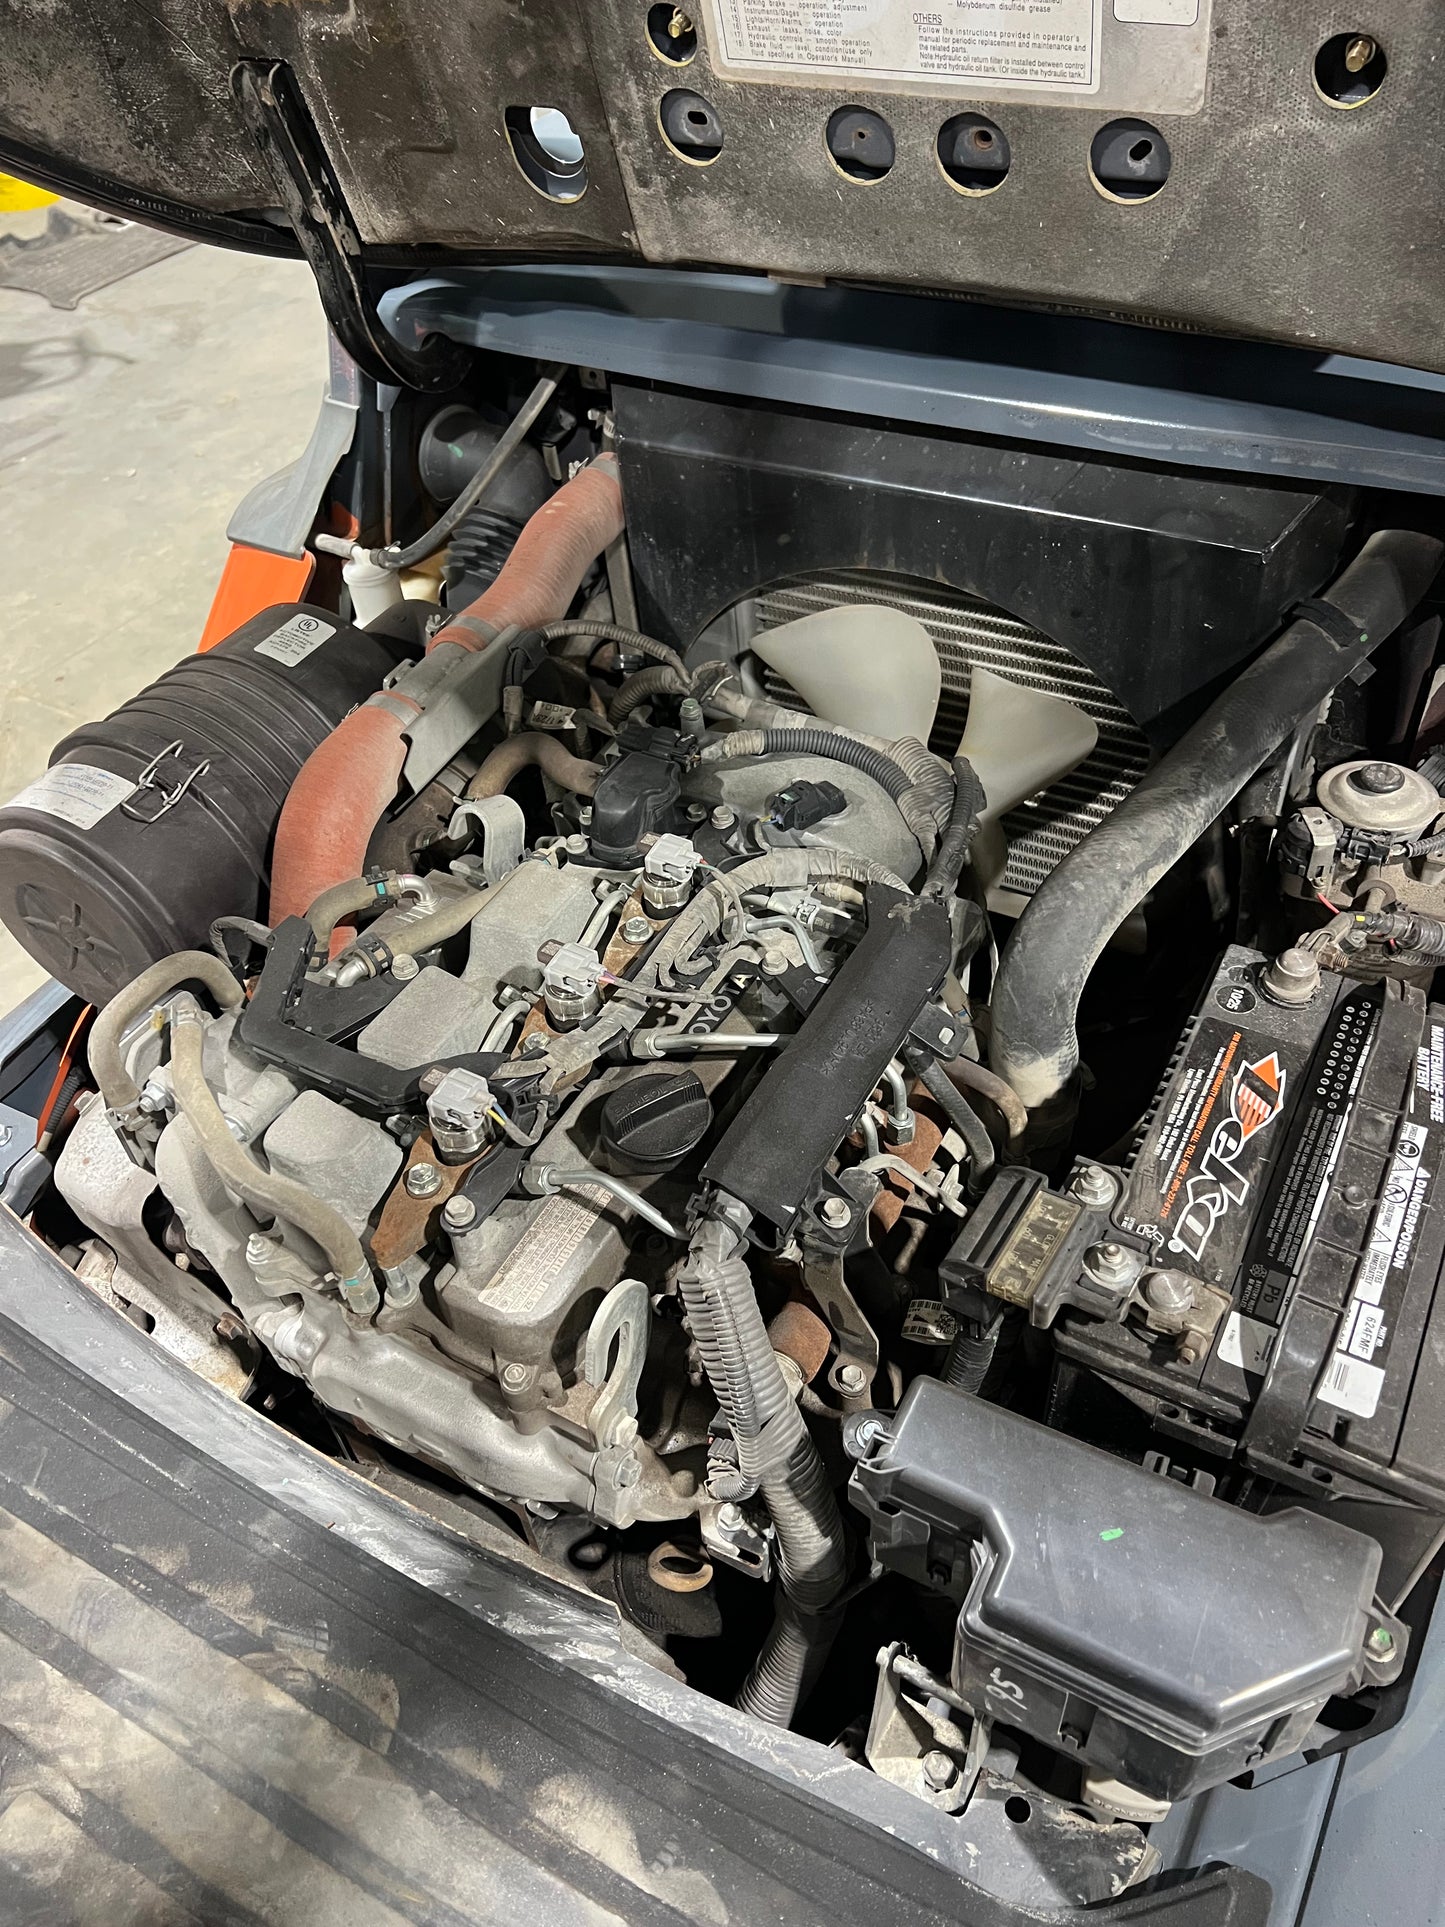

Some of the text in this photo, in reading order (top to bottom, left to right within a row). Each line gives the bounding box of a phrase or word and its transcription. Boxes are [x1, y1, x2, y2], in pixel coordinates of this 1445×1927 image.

[912, 13, 942, 23] OTHERS
[1028, 5, 1050, 13] grease
[918, 25, 940, 33] Follow
[942, 26, 953, 34] the
[956, 28, 996, 36] instructions
[999, 30, 1030, 40] provided
[1031, 42, 1072, 50] maintenance
[687, 972, 752, 1046] OYOTA
[1224, 985, 1245, 1011] 10/25
[1231, 1031, 1241, 1042] FOR
[1417, 1046, 1429, 1091] BATTERY
[1431, 1024, 1443, 1123] MAINTENANCE-FREE
[1174, 1051, 1286, 1262] Deka
[1381, 1203, 1395, 1227] SULFURIC
[1391, 1178, 1427, 1269] DANGER/POISON
[1363, 1251, 1379, 1285] IMMEDIATELY
[1374, 1255, 1388, 1284] FLUSH EYES
[1262, 1283, 1281, 1305] Pb
[1357, 1315, 1376, 1354] 624FMF
[1377, 1325, 1387, 1338] PART
